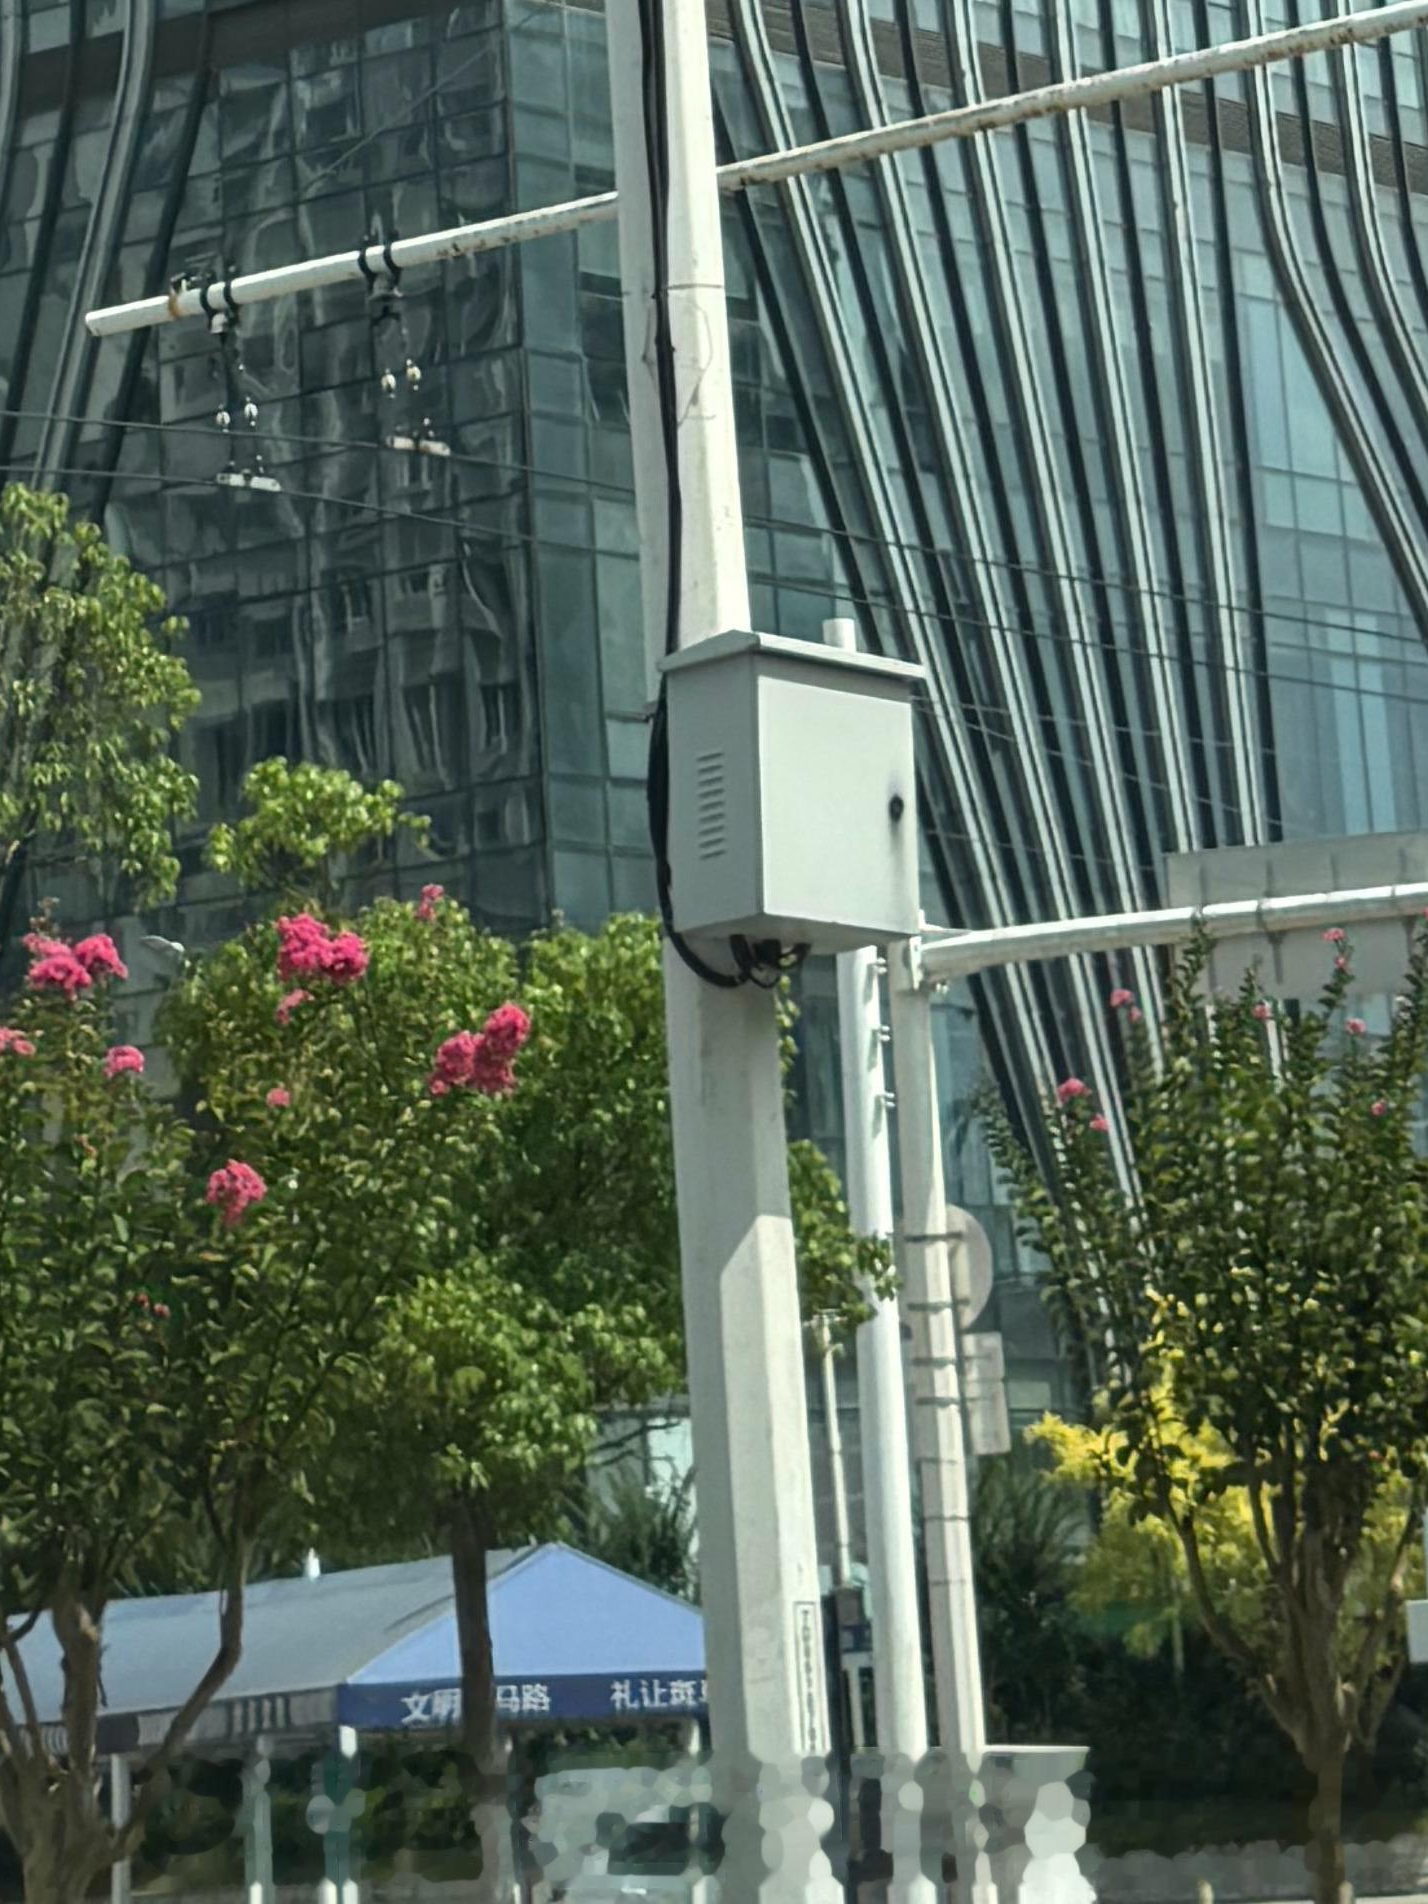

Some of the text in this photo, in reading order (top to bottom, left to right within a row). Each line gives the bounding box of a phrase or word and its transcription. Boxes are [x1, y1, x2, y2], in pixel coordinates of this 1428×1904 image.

[400, 1679, 708, 1726] 文明马路 礼让斑
